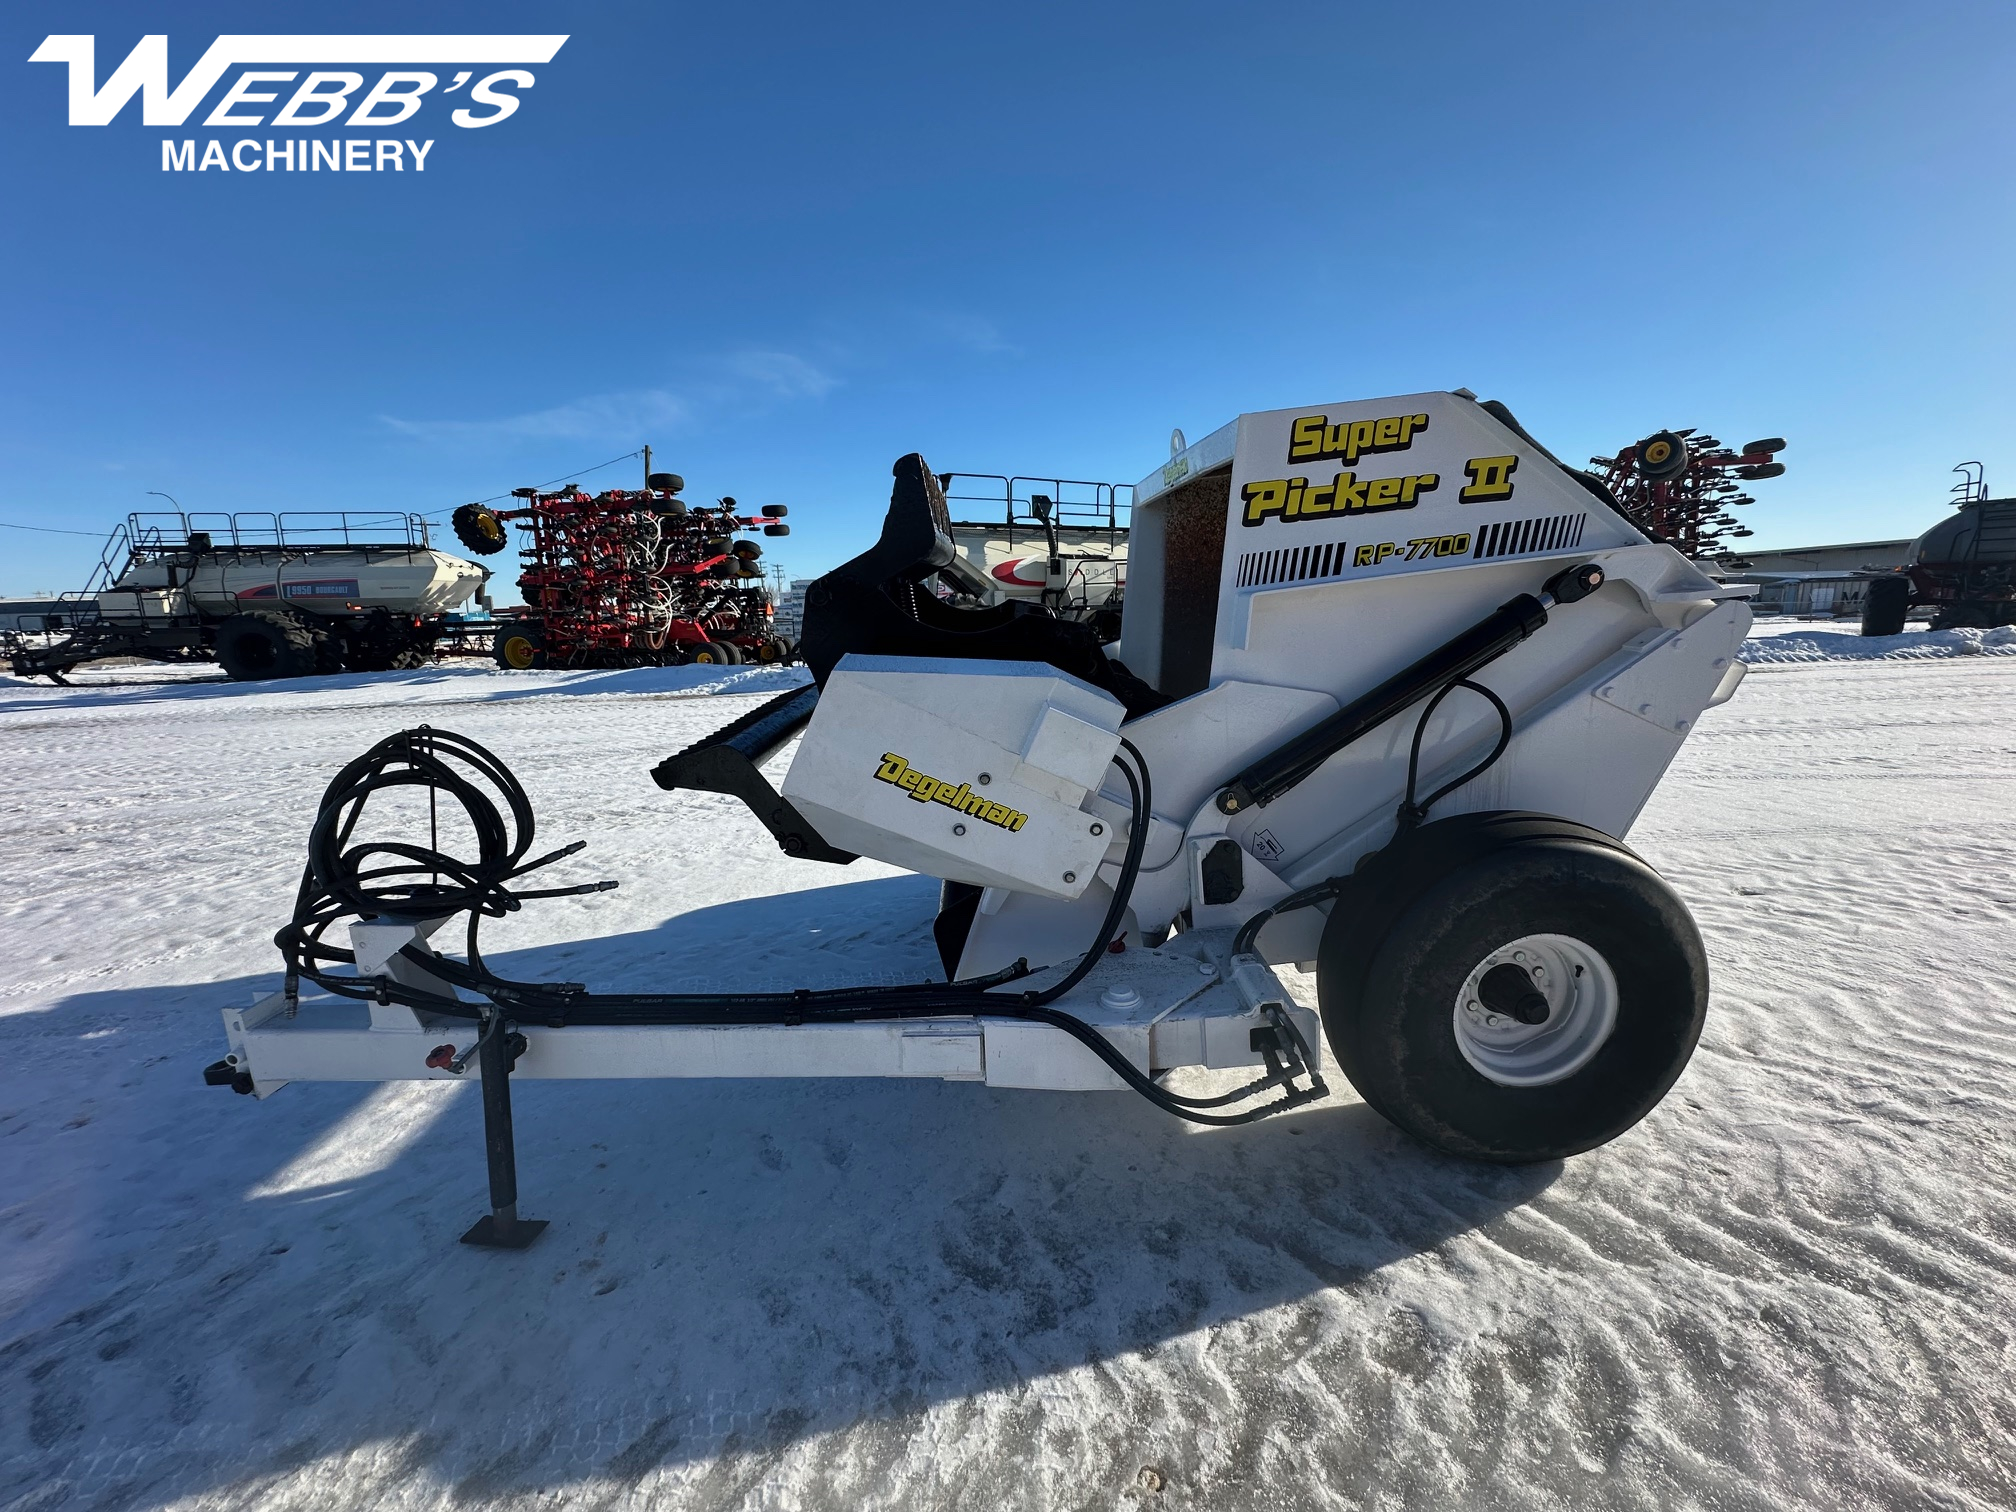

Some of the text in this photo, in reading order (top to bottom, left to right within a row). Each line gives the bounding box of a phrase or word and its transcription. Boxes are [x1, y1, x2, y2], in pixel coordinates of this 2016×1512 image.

[1287, 413, 1429, 466] Super
[1241, 471, 1441, 528] Picker
[1458, 454, 1519, 505] II
[1352, 532, 1472, 569] RP-7700
[315, 585, 349, 594] BOURGAULT
[873, 751, 1030, 833] Degelman
